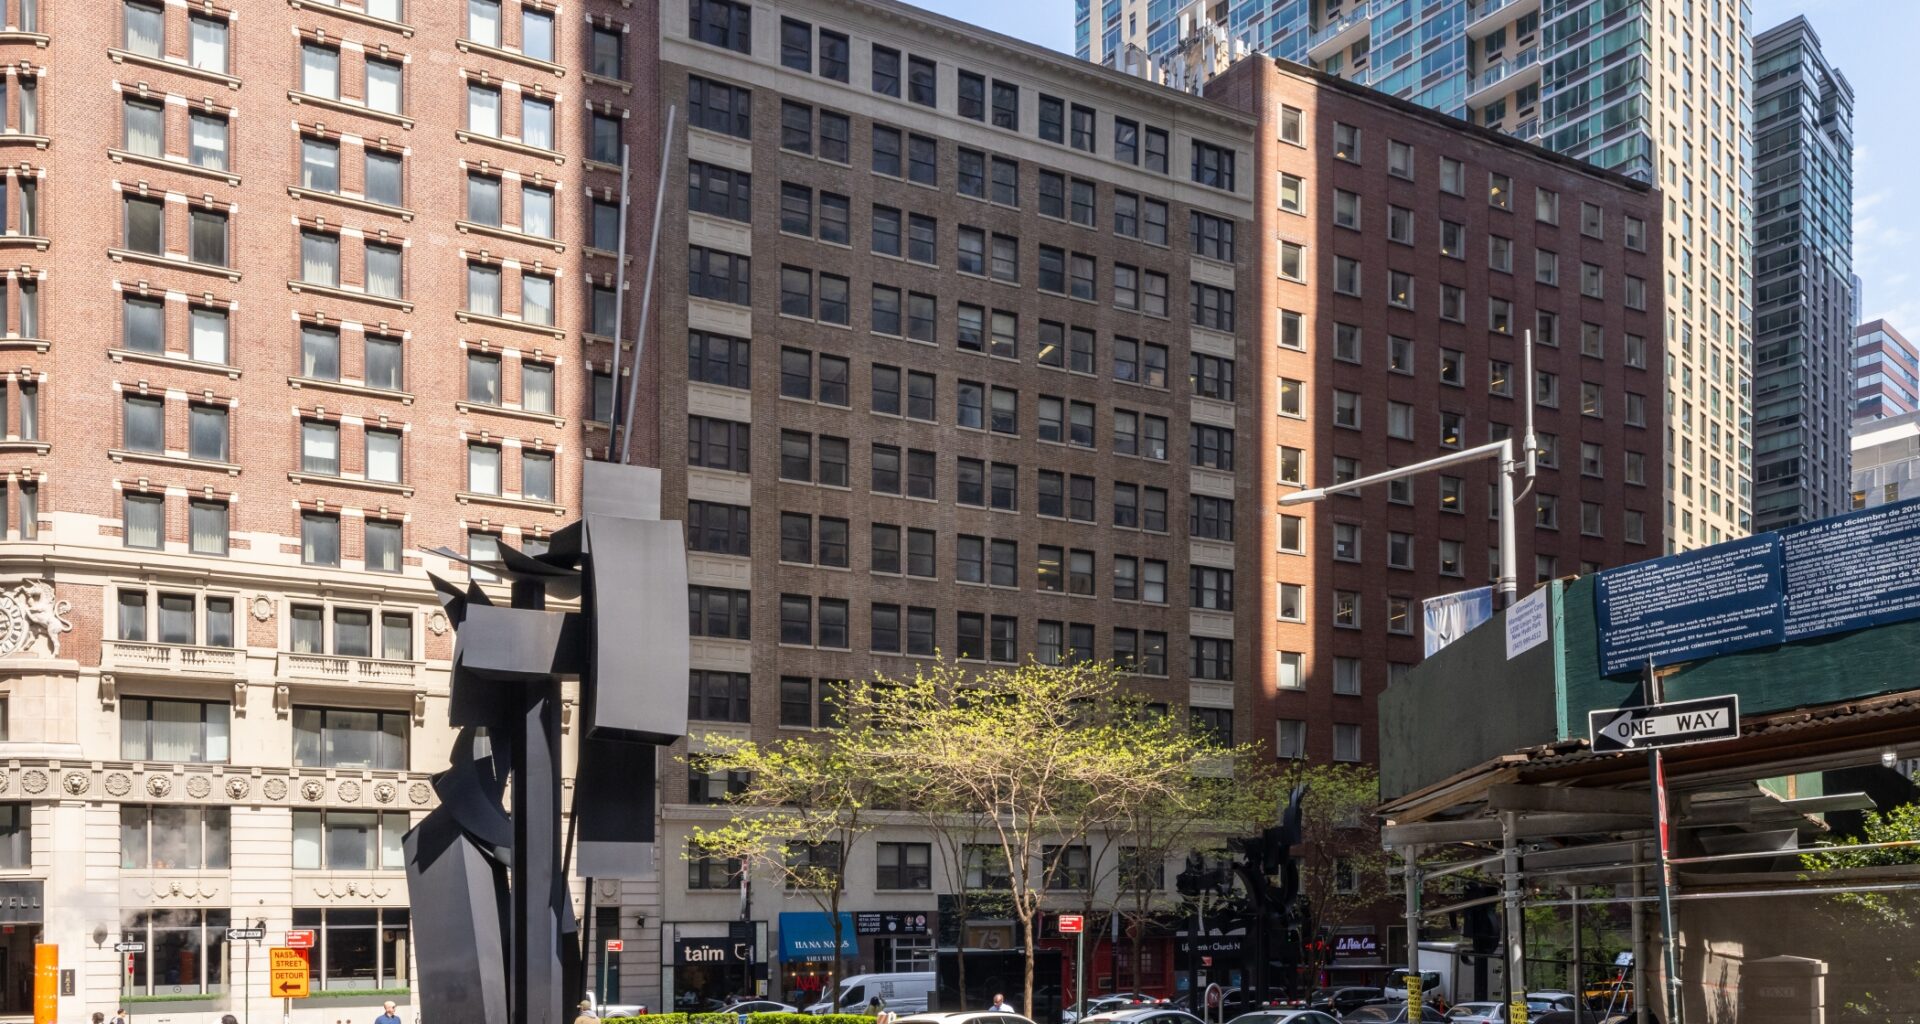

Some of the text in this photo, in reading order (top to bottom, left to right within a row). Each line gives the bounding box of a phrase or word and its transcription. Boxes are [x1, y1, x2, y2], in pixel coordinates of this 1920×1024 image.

[1778, 533, 1784, 542] A
[1786, 528, 1808, 541] partir
[1809, 525, 1822, 535] del
[1824, 523, 1829, 531] 1
[1831, 520, 1842, 530] de
[1843, 510, 1886, 527] diciembre
[1888, 507, 1899, 517] de
[1782, 593, 1789, 601] A
[1790, 588, 1812, 601] partir
[1813, 586, 1827, 595] del
[1828, 584, 1834, 592] 1
[1835, 582, 1846, 591] de
[1847, 572, 1896, 590] septiembre
[1898, 569, 1909, 578] de
[1617, 710, 1720, 738] ONE WAY
[979, 930, 1001, 949] 75
[1212, 942, 1234, 951] Church
[274, 951, 304, 959] NASSAU
[684, 945, 725, 961] taïm
[275, 972, 304, 980] DETOUR
